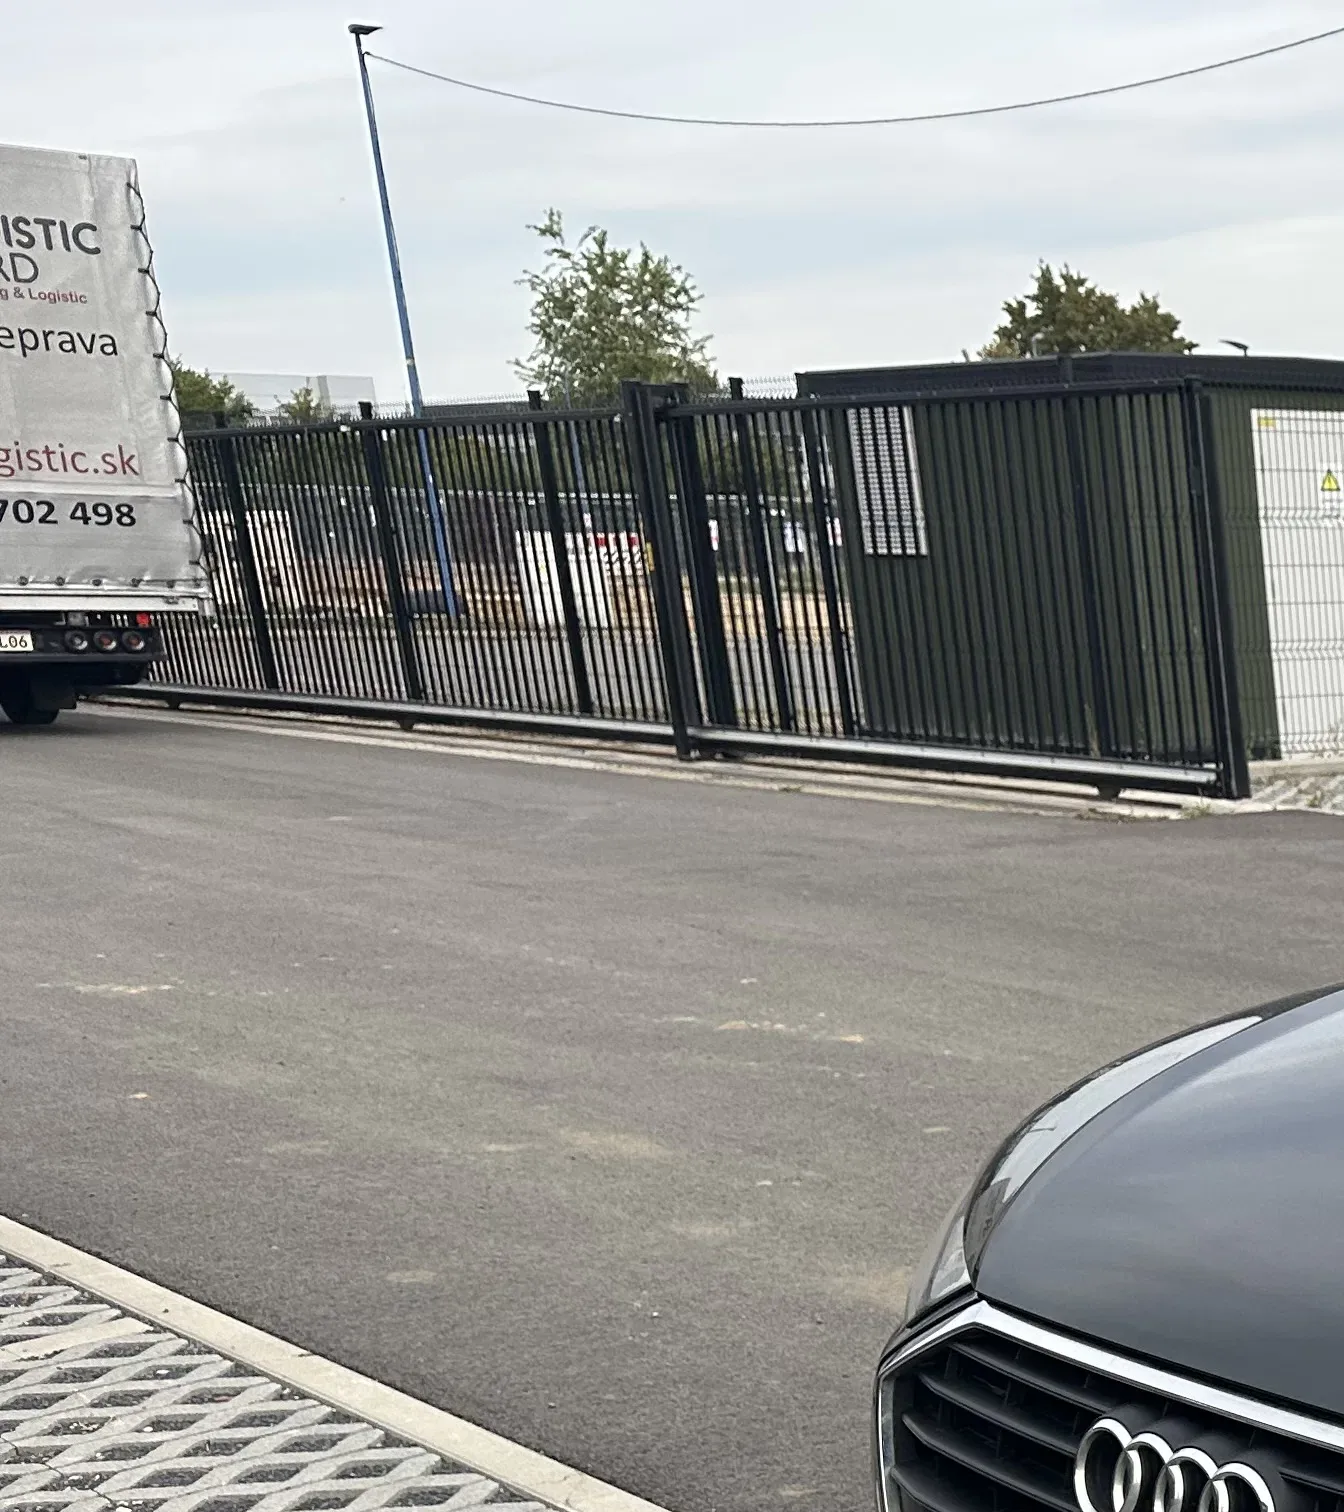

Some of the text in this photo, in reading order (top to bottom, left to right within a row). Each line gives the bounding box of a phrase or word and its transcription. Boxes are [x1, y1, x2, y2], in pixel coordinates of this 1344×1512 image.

[0, 214, 101, 255] ISTIC
[13, 286, 25, 299] &
[28, 288, 88, 304] Logistic
[0, 326, 118, 358] eprava
[0, 441, 139, 477] gistic.sk
[69, 502, 136, 527] 498
